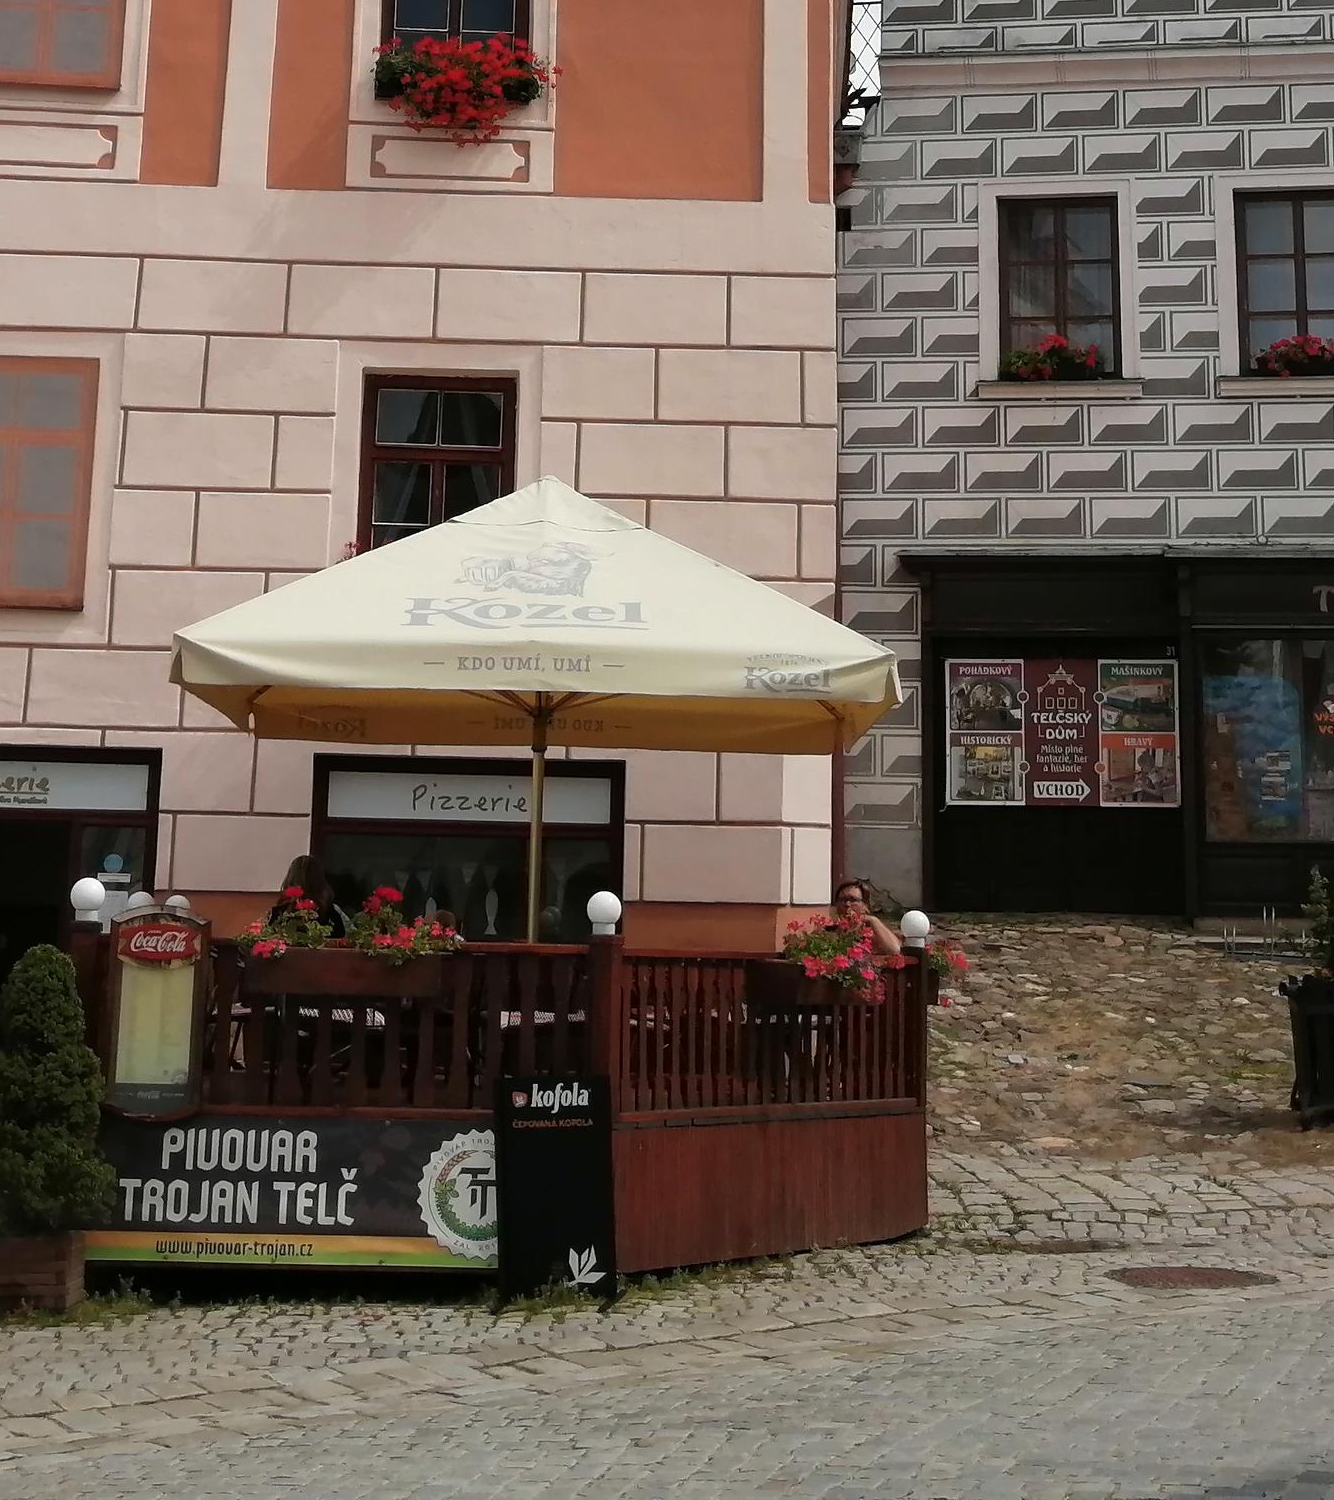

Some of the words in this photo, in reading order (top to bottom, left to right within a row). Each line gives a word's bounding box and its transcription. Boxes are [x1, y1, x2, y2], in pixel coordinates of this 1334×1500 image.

[400, 597, 650, 630] Kozel
[457, 656, 496, 671] KDO
[502, 653, 545, 672] UMÍ,
[553, 653, 591, 673] UMÍ
[744, 666, 834, 693] Kozel
[1031, 709, 1093, 725] TELČSKÝ
[959, 734, 1013, 745] HISTORICKÝ
[1045, 725, 1078, 740] DŮM
[410, 782, 528, 813] Pizzerie
[1036, 783, 1085, 796] VCHOD
[530, 1081, 590, 1114] kofola
[558, 1118, 594, 1128] KOFOLA
[119, 1178, 260, 1224] TROJAN
[273, 1167, 359, 1226] TELČ
